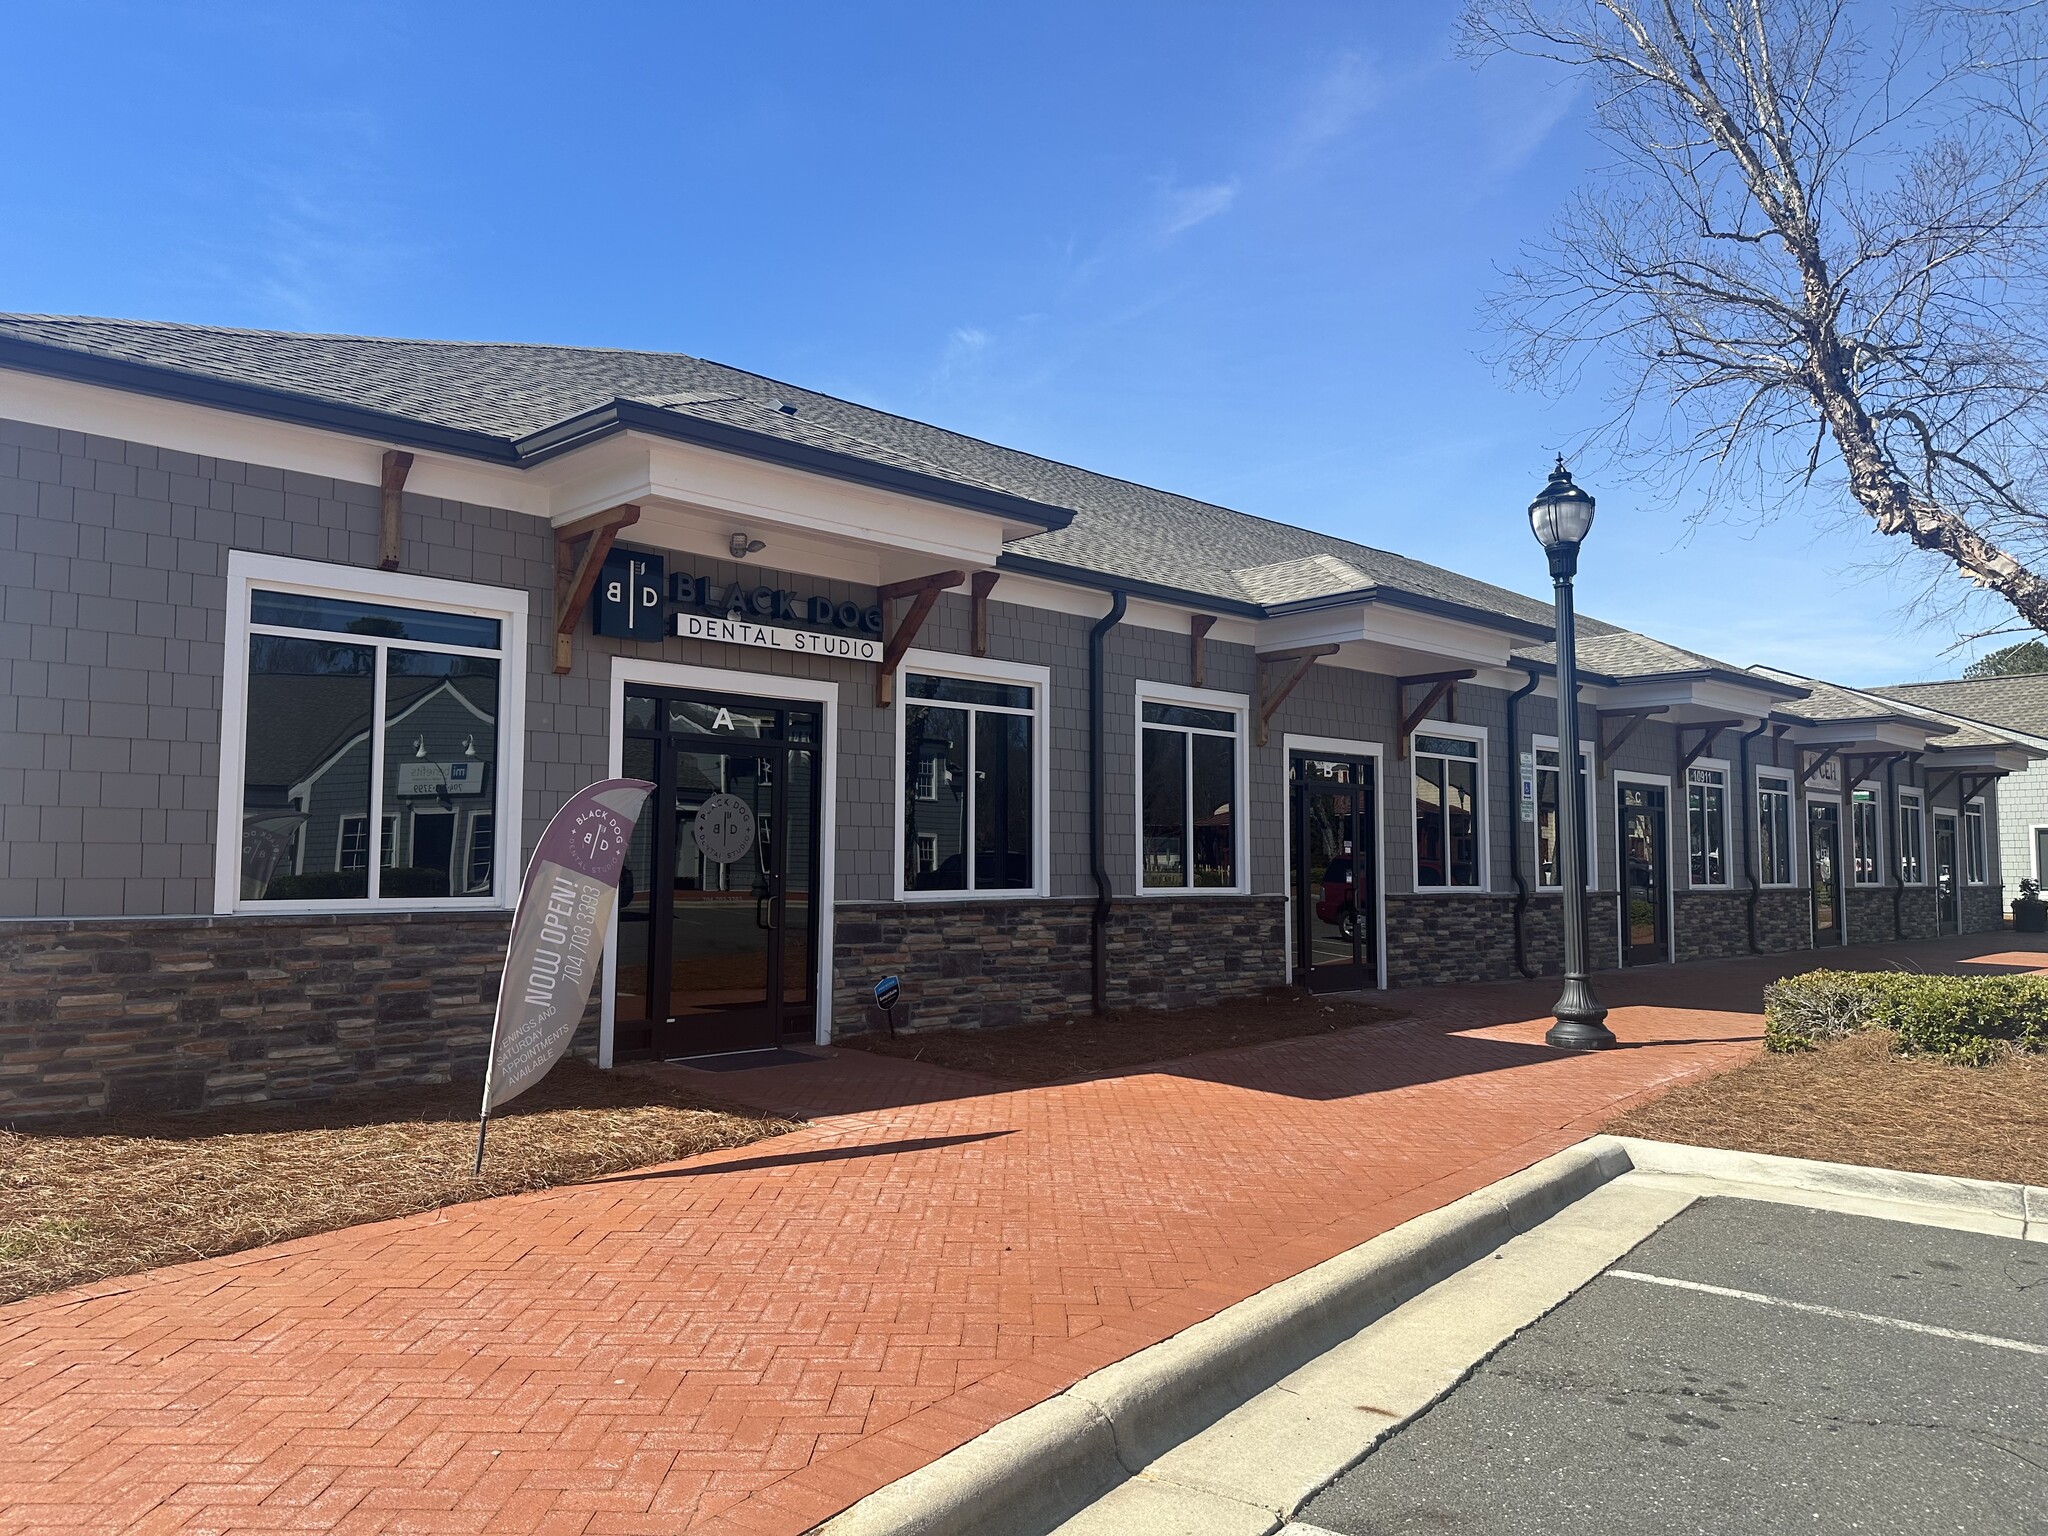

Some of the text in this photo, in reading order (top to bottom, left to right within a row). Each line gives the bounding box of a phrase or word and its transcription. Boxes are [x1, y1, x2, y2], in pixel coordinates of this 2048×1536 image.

[669, 571, 884, 633] BLACK DOG
[689, 617, 874, 658] DENTAL STUDIO
[712, 707, 734, 731] A
[1323, 763, 1333, 778] B
[1693, 770, 1712, 783] 10911
[733, 801, 750, 822] DOG
[1635, 791, 1641, 803] C
[576, 809, 623, 844] BLACK DOG
[727, 835, 750, 859] STUDIO
[524, 877, 579, 1007] NOW OPEN!
[562, 885, 601, 985] 704 703 3393
[538, 1005, 556, 1024] AND
[496, 1027, 543, 1066] SATURDAY
[502, 1023, 569, 1077] APPOINTMENTS
[509, 1047, 554, 1087] AVAILABLE
